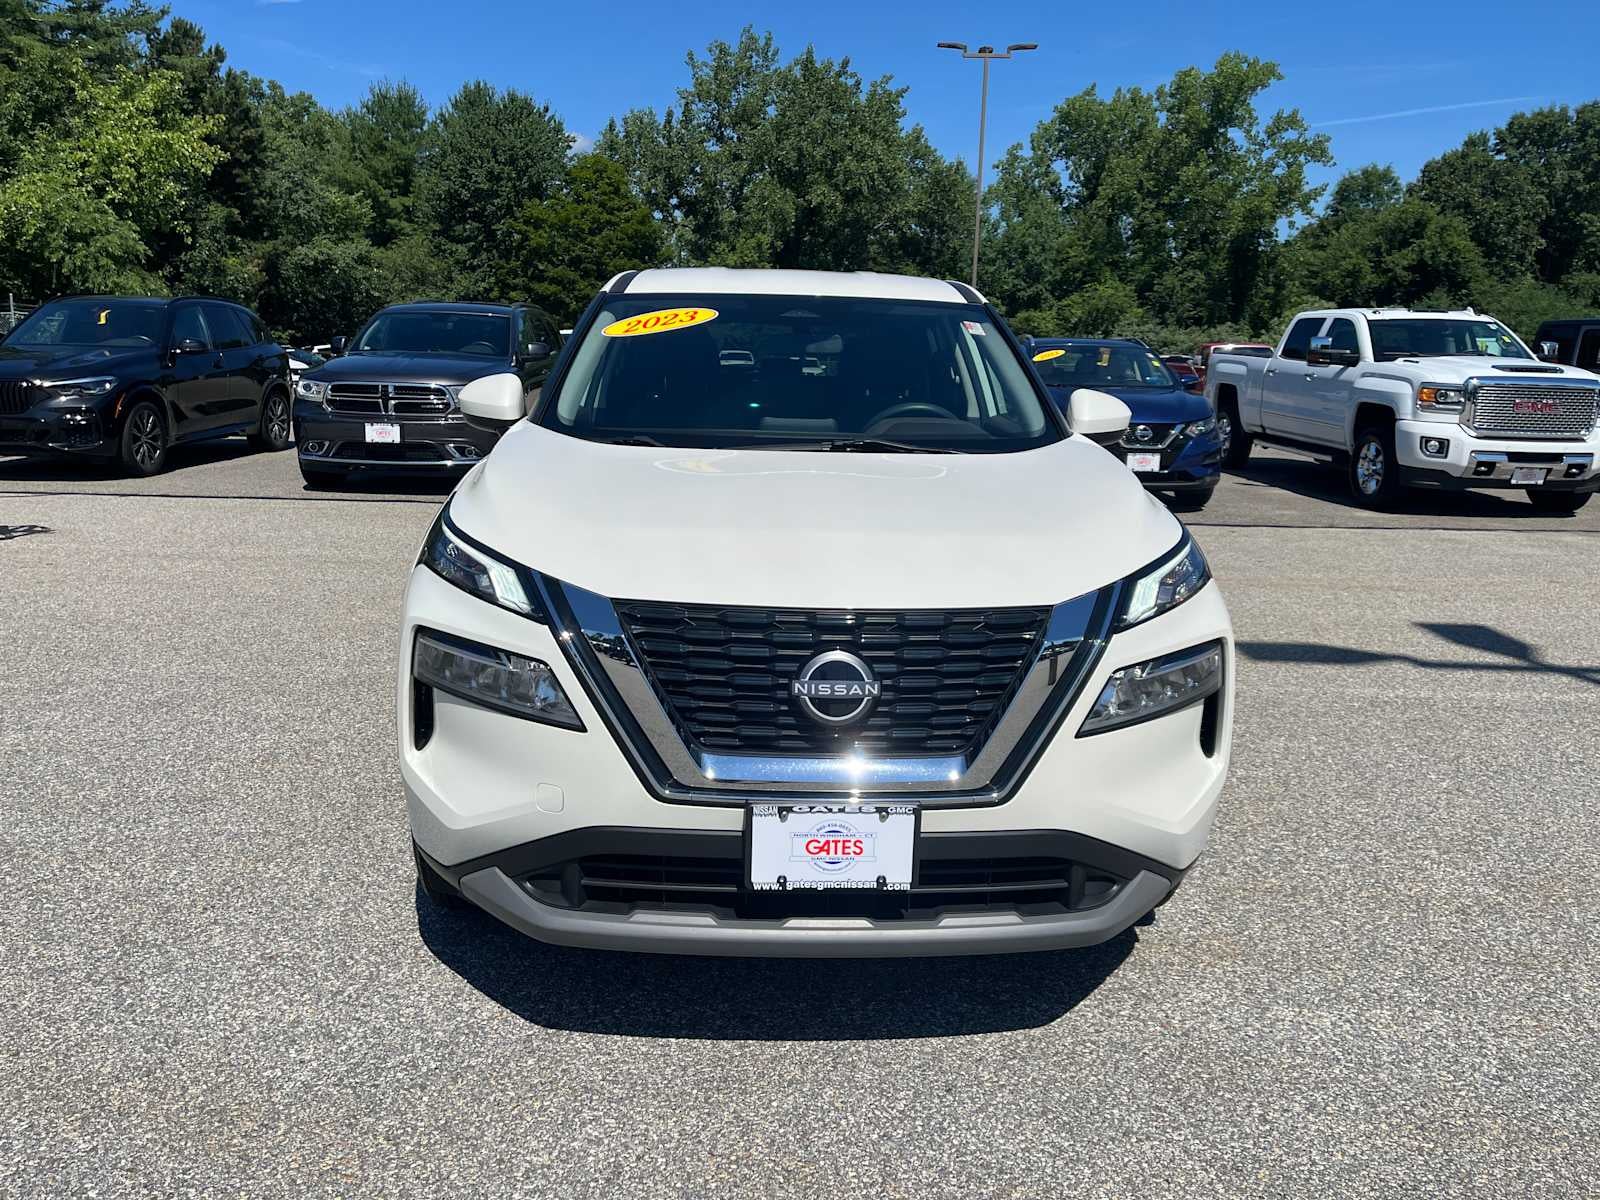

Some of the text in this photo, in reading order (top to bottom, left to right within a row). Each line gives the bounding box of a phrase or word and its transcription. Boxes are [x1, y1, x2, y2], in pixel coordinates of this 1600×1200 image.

[622, 310, 699, 334] 2023
[1513, 399, 1561, 414] GMC
[794, 682, 878, 695] NISSAN
[753, 805, 914, 815] NISSAN GATES GMC
[805, 838, 865, 856] GATES
